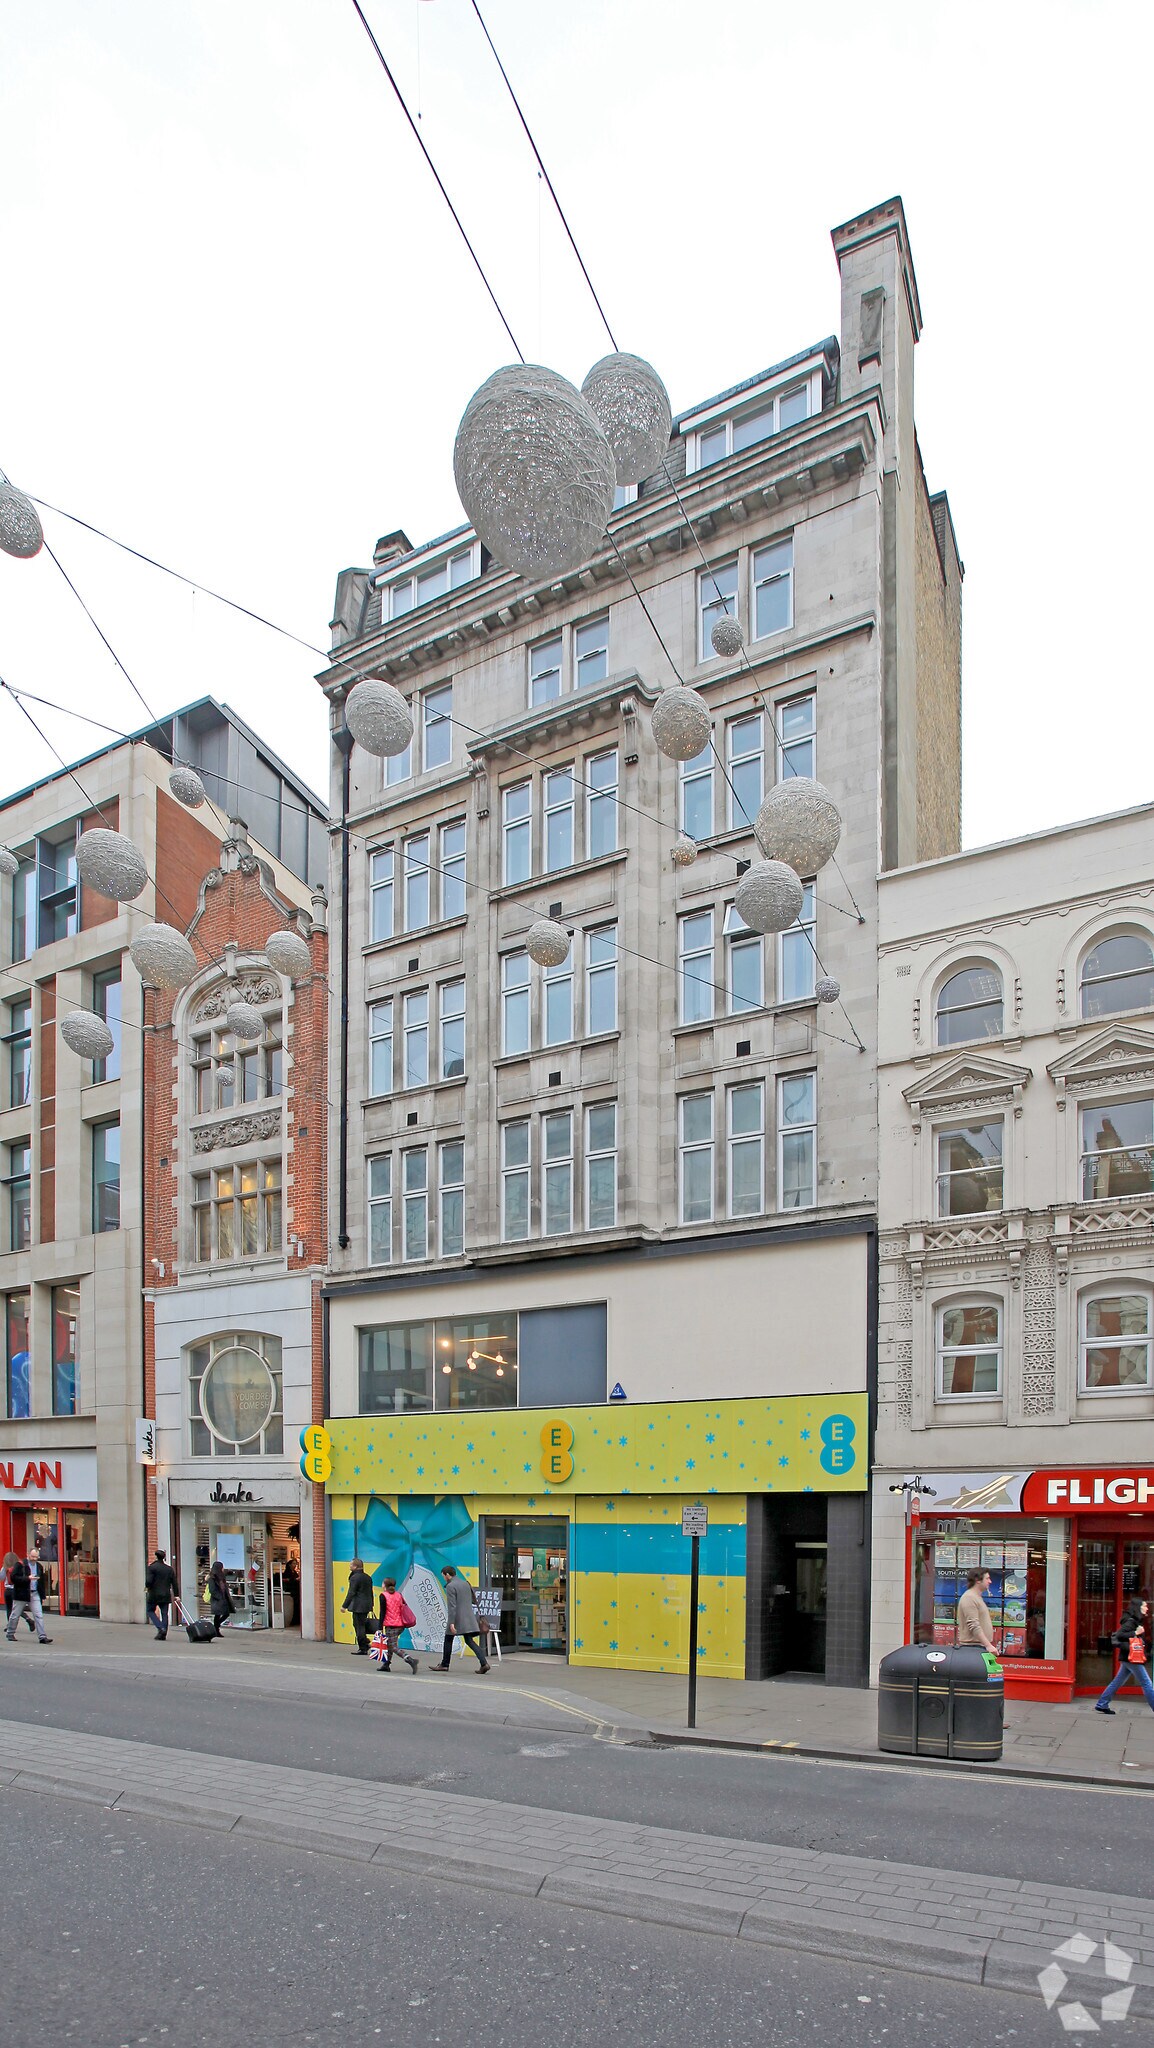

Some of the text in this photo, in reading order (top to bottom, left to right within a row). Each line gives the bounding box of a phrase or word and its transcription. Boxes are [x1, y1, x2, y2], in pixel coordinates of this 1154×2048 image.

[235, 1391, 255, 1401] YOUR
[239, 1401, 260, 1410] COME
[209, 1481, 264, 1504] ulanka
[412, 1584, 433, 1627] CHANGING
[418, 1580, 433, 1607] TODAY
[430, 1608, 439, 1625] FOR
[424, 1578, 448, 1631] COME IN STO
[475, 1590, 500, 1601] FREE
